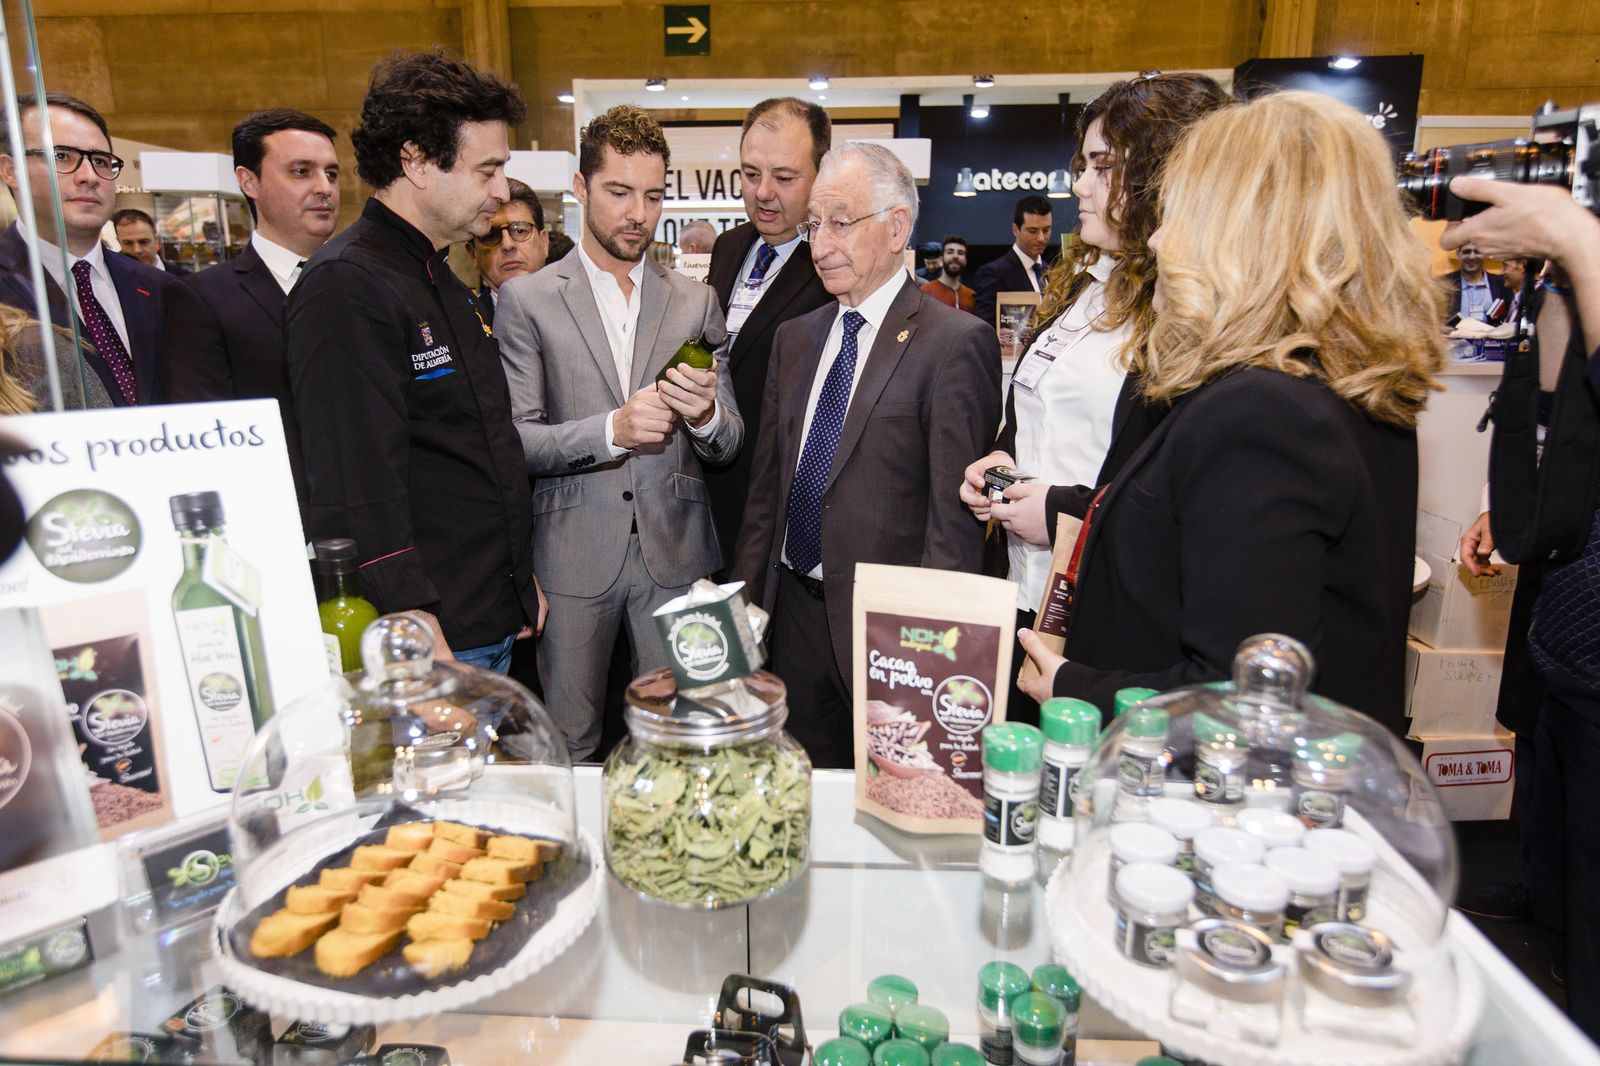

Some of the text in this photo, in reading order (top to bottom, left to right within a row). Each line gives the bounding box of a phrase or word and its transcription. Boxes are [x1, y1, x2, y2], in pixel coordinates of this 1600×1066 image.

[664, 168, 742, 200] EL VAC
[411, 345, 449, 362] DIPUTACIÓN
[413, 354, 453, 370] DE ALMERÍA
[85, 418, 265, 473] productos
[869, 649, 917, 678] Cacao
[1437, 760, 1502, 777] TOMA & TOMA
